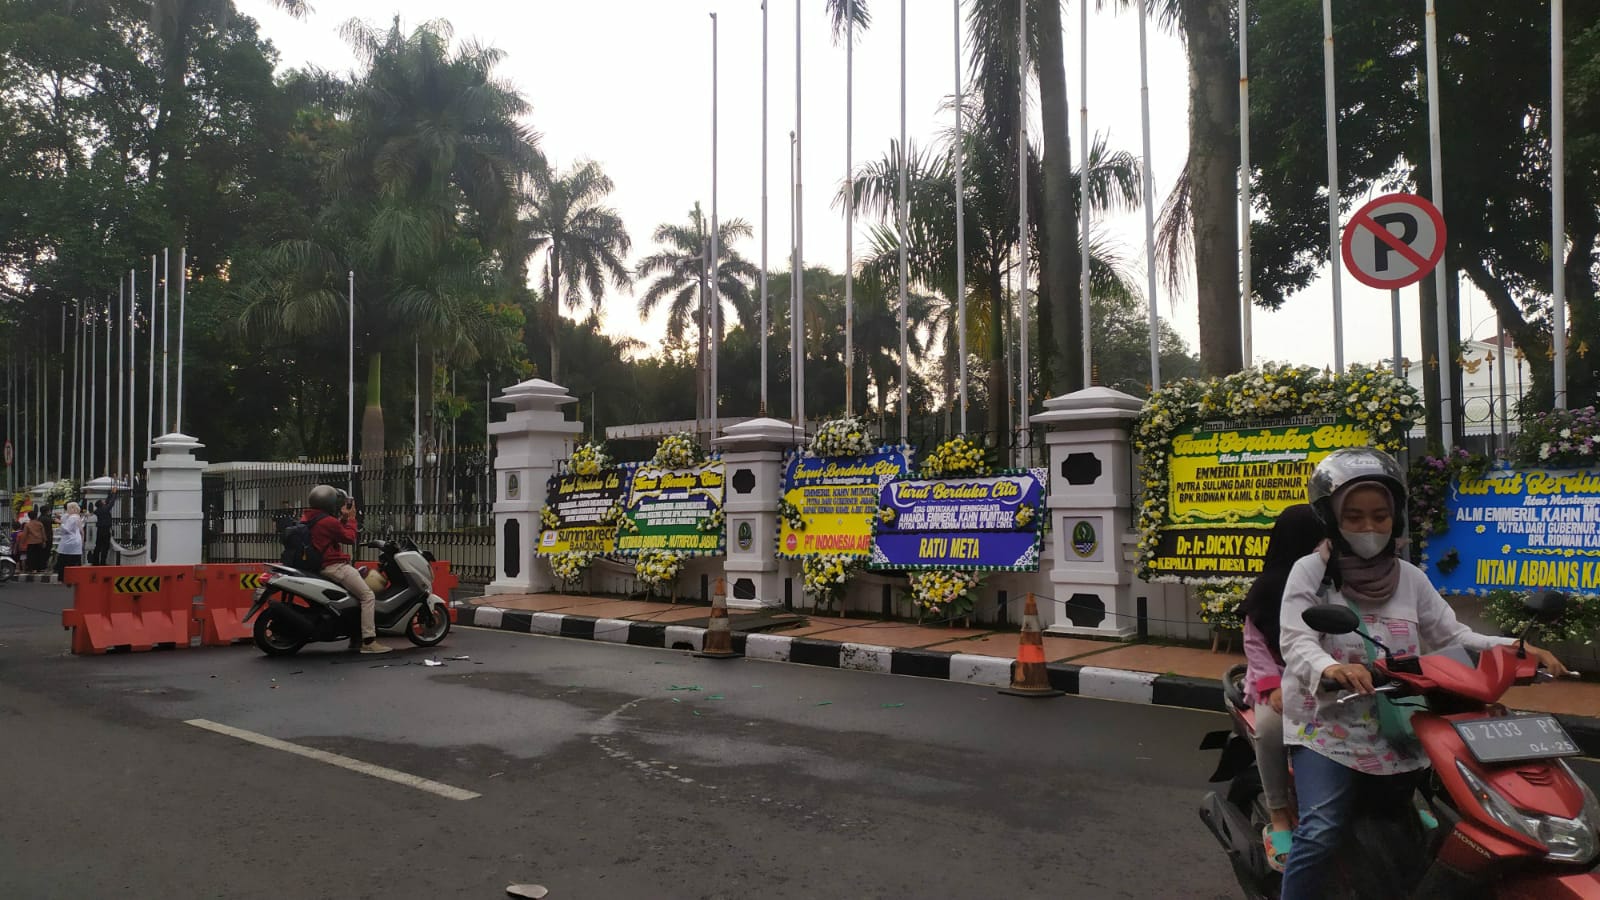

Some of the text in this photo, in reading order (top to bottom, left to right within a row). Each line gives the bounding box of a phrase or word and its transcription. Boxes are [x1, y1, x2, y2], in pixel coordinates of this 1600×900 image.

[1373, 212, 1418, 272] P
[1218, 428, 1312, 453] Berduka
[1312, 425, 1369, 449] Cita
[1195, 466, 1241, 480] EMMERIL
[1243, 464, 1274, 478] KAHN
[898, 481, 1019, 499] Turut Berduka Cita
[1176, 480, 1201, 491] PUTRA
[1202, 479, 1234, 491] SULUNG
[1235, 478, 1254, 489] DARI
[1255, 476, 1302, 488] GUBERNUR
[1227, 491, 1253, 502] KAMIL
[1254, 491, 1260, 501] &
[1261, 490, 1276, 501] IBU
[1277, 489, 1306, 500] ATALIA
[959, 511, 979, 522] KAHN
[980, 511, 1014, 521] MUMTADZ
[1456, 507, 1483, 521] ALM
[1484, 507, 1540, 522] EMMERIL
[1541, 507, 1581, 522] KAHN
[1497, 522, 1524, 533] PUTRA
[1525, 522, 1546, 533] DARI
[1547, 522, 1596, 534] GUBERNUR
[803, 535, 815, 550] PT
[816, 534, 856, 550] INDONESIA
[918, 538, 980, 559] RATU META
[1157, 557, 1193, 570] KEPALA
[1219, 558, 1245, 571] DESA
[1476, 559, 1517, 585] INTAN
[1480, 721, 1523, 739] 2133
[1454, 829, 1491, 859] HONDA
